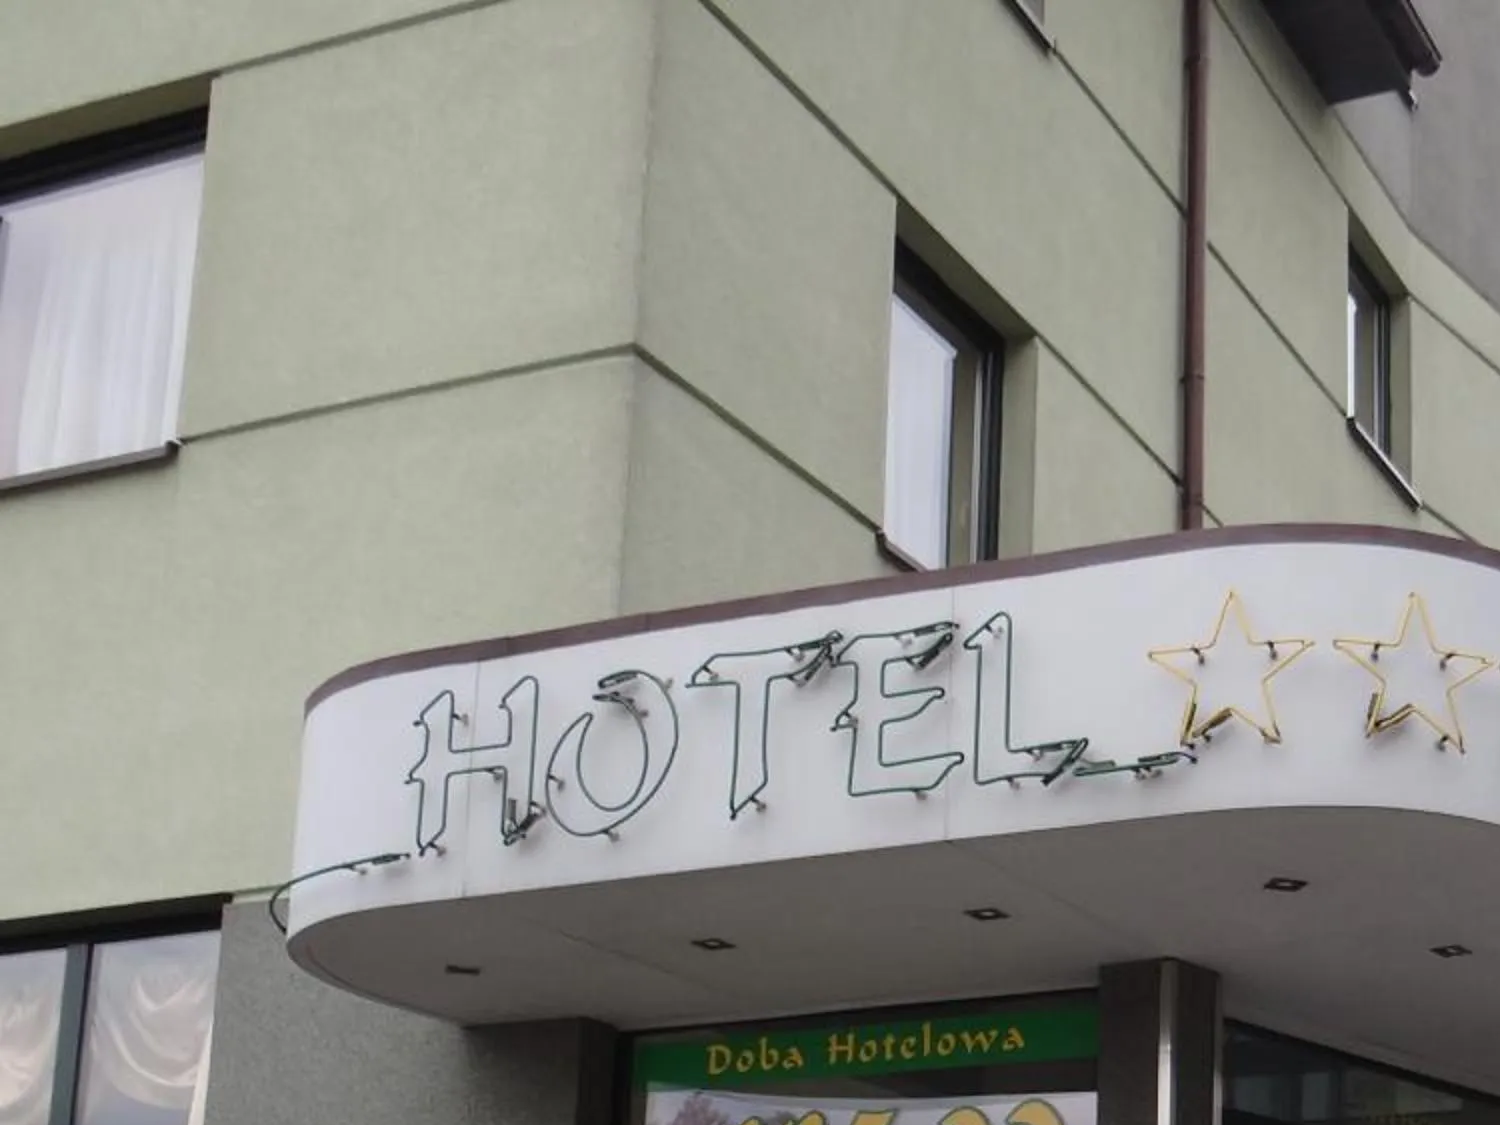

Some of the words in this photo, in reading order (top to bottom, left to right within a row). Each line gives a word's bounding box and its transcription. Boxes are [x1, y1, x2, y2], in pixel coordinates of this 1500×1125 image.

[406, 611, 1090, 856] HOTEL
[706, 1037, 804, 1076] Doba
[827, 1021, 1026, 1065] Hotelowa
